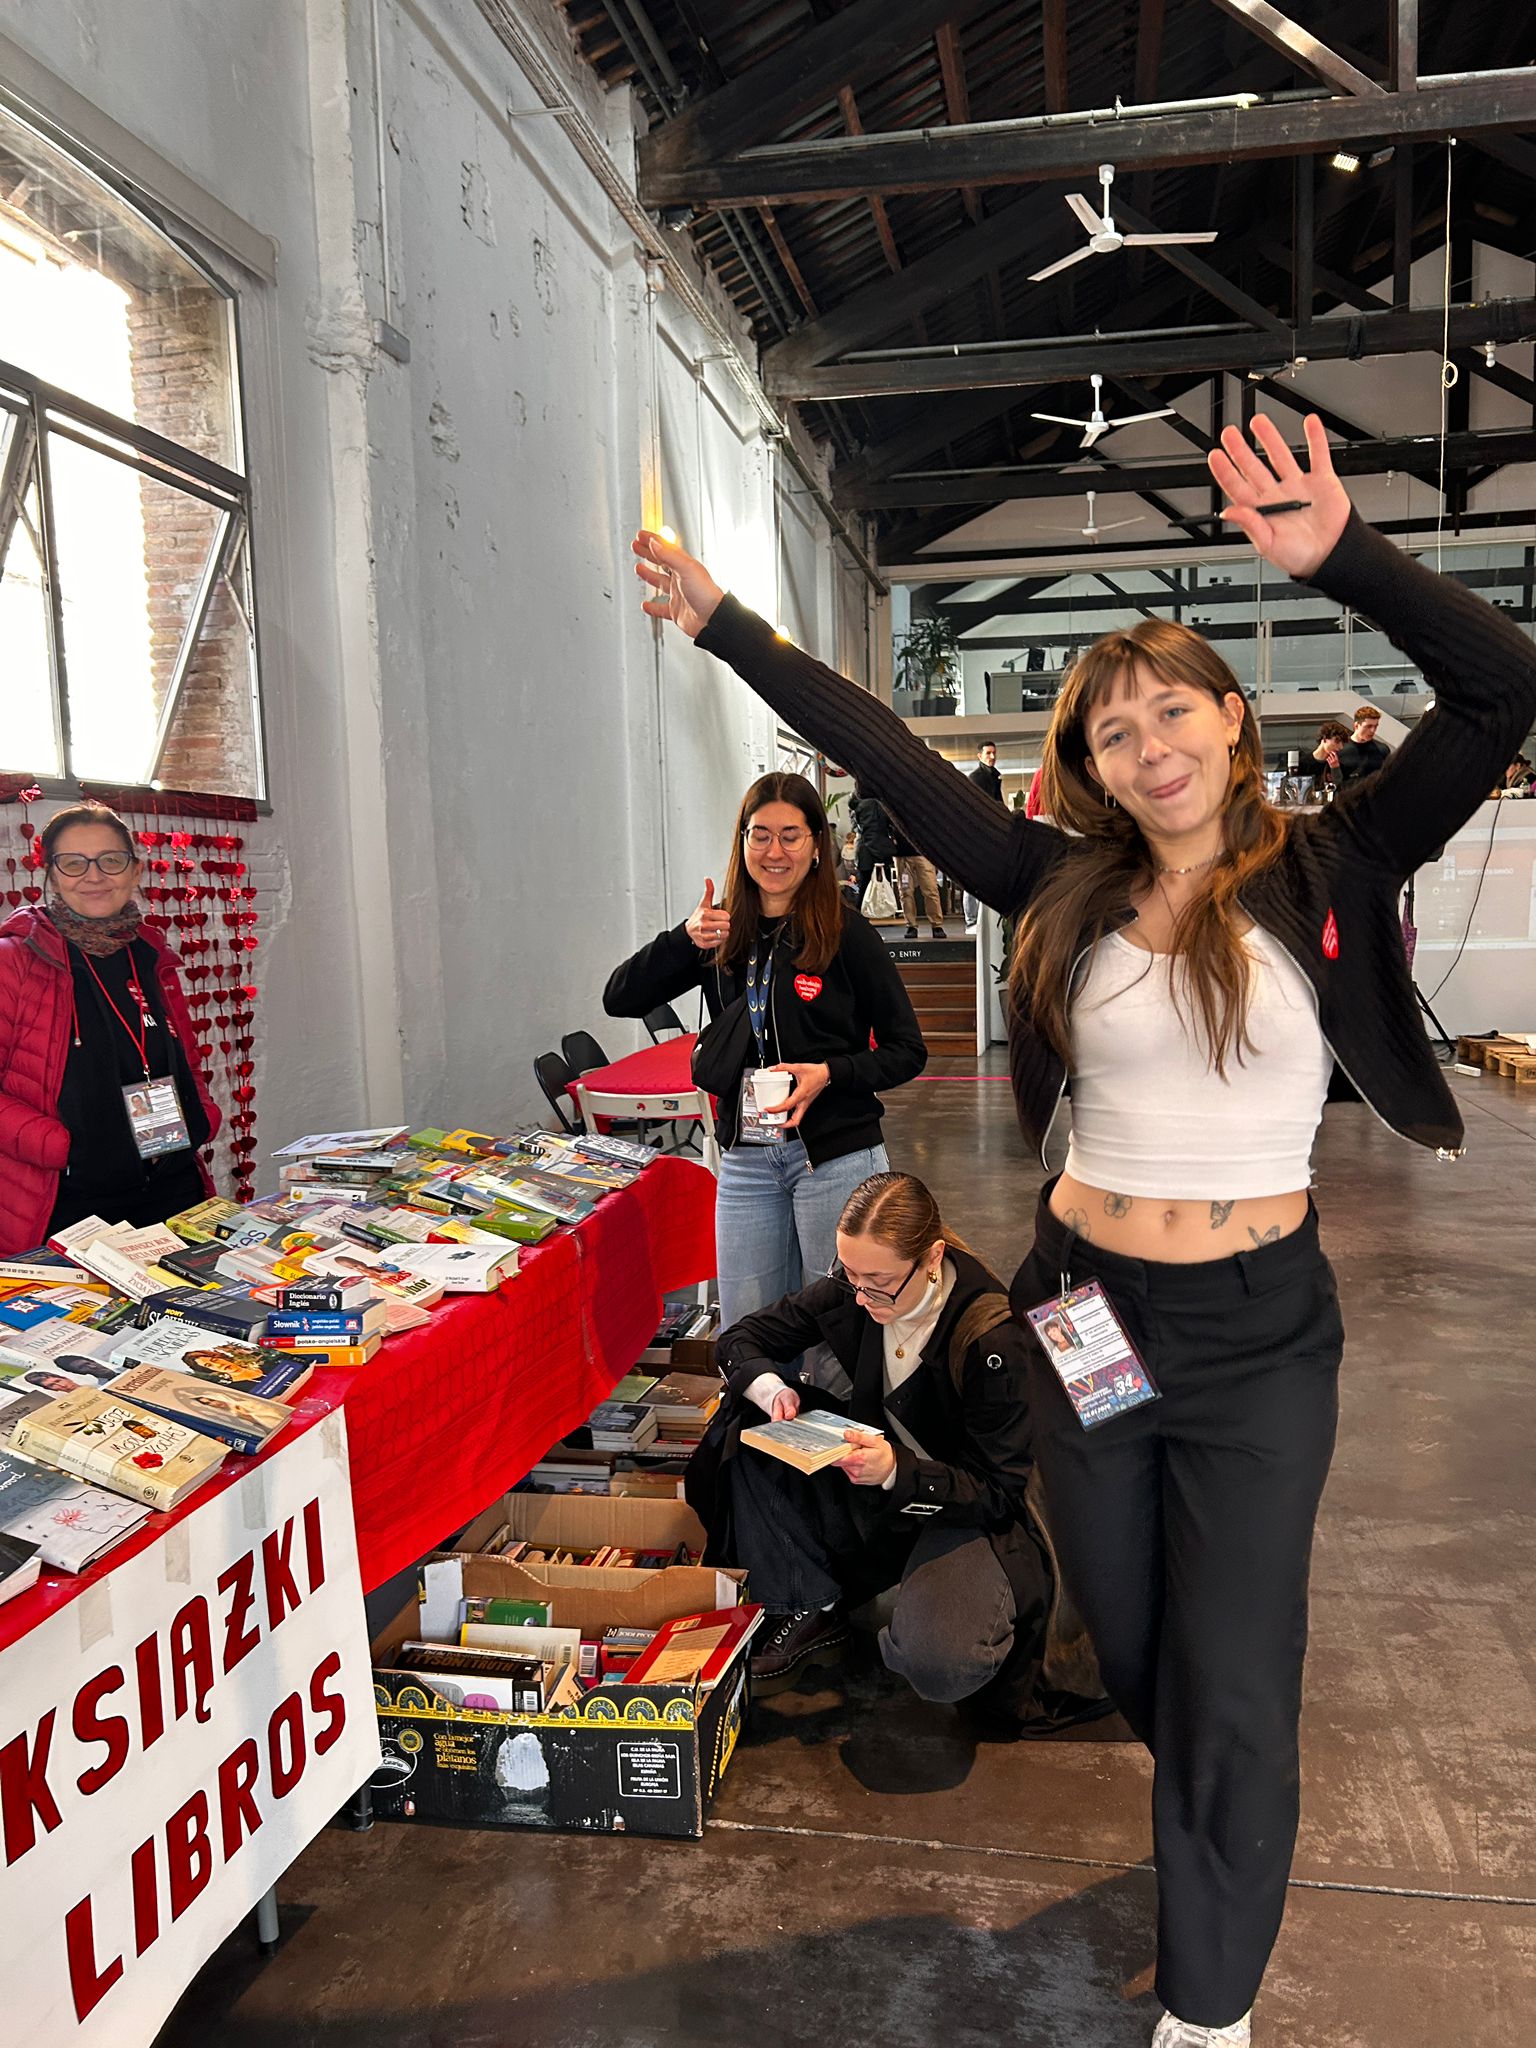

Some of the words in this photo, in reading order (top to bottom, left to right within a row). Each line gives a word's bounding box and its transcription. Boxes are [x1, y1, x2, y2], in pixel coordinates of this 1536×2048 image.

[289, 1292, 327, 1300] Diccionario
[289, 1300, 310, 1308] Inglés
[273, 1320, 300, 1329] Słownik
[297, 1337, 346, 1346] polsko-angielskie
[1116, 1372, 1134, 1396] 34
[433, 1732, 448, 1740] Con
[434, 1740, 456, 1748] agua
[436, 1752, 478, 1764] plátanos
[65, 1651, 346, 2025] LIBROS
